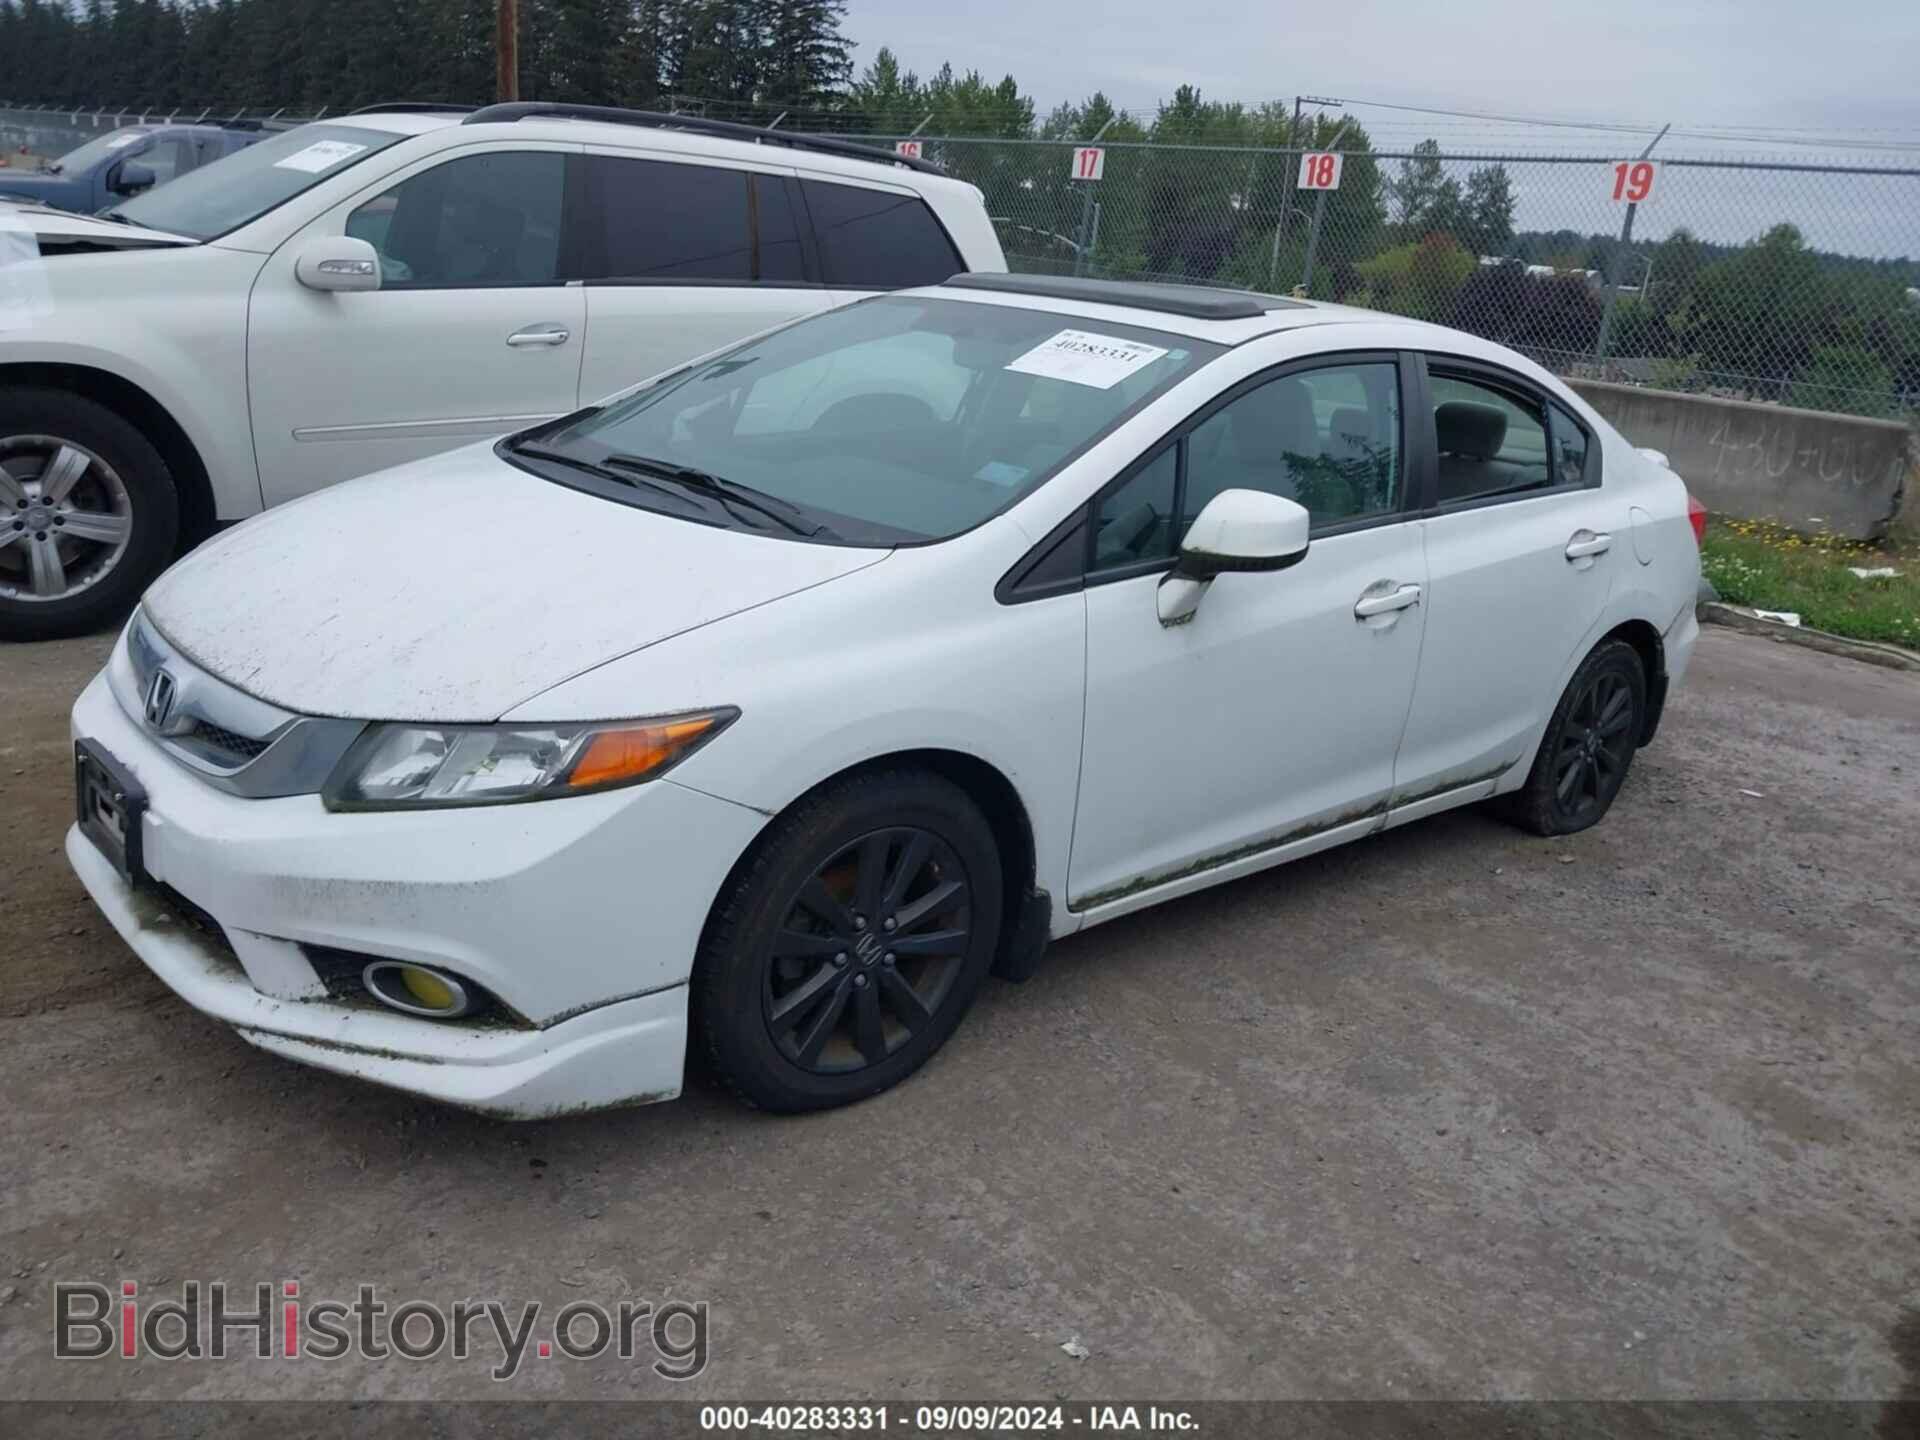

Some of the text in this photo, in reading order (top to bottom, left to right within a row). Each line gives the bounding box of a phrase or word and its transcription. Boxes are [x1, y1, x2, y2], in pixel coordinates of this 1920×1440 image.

[1080, 150, 1098, 177] 17
[1307, 155, 1335, 187] 18
[1613, 162, 1654, 201] 19
